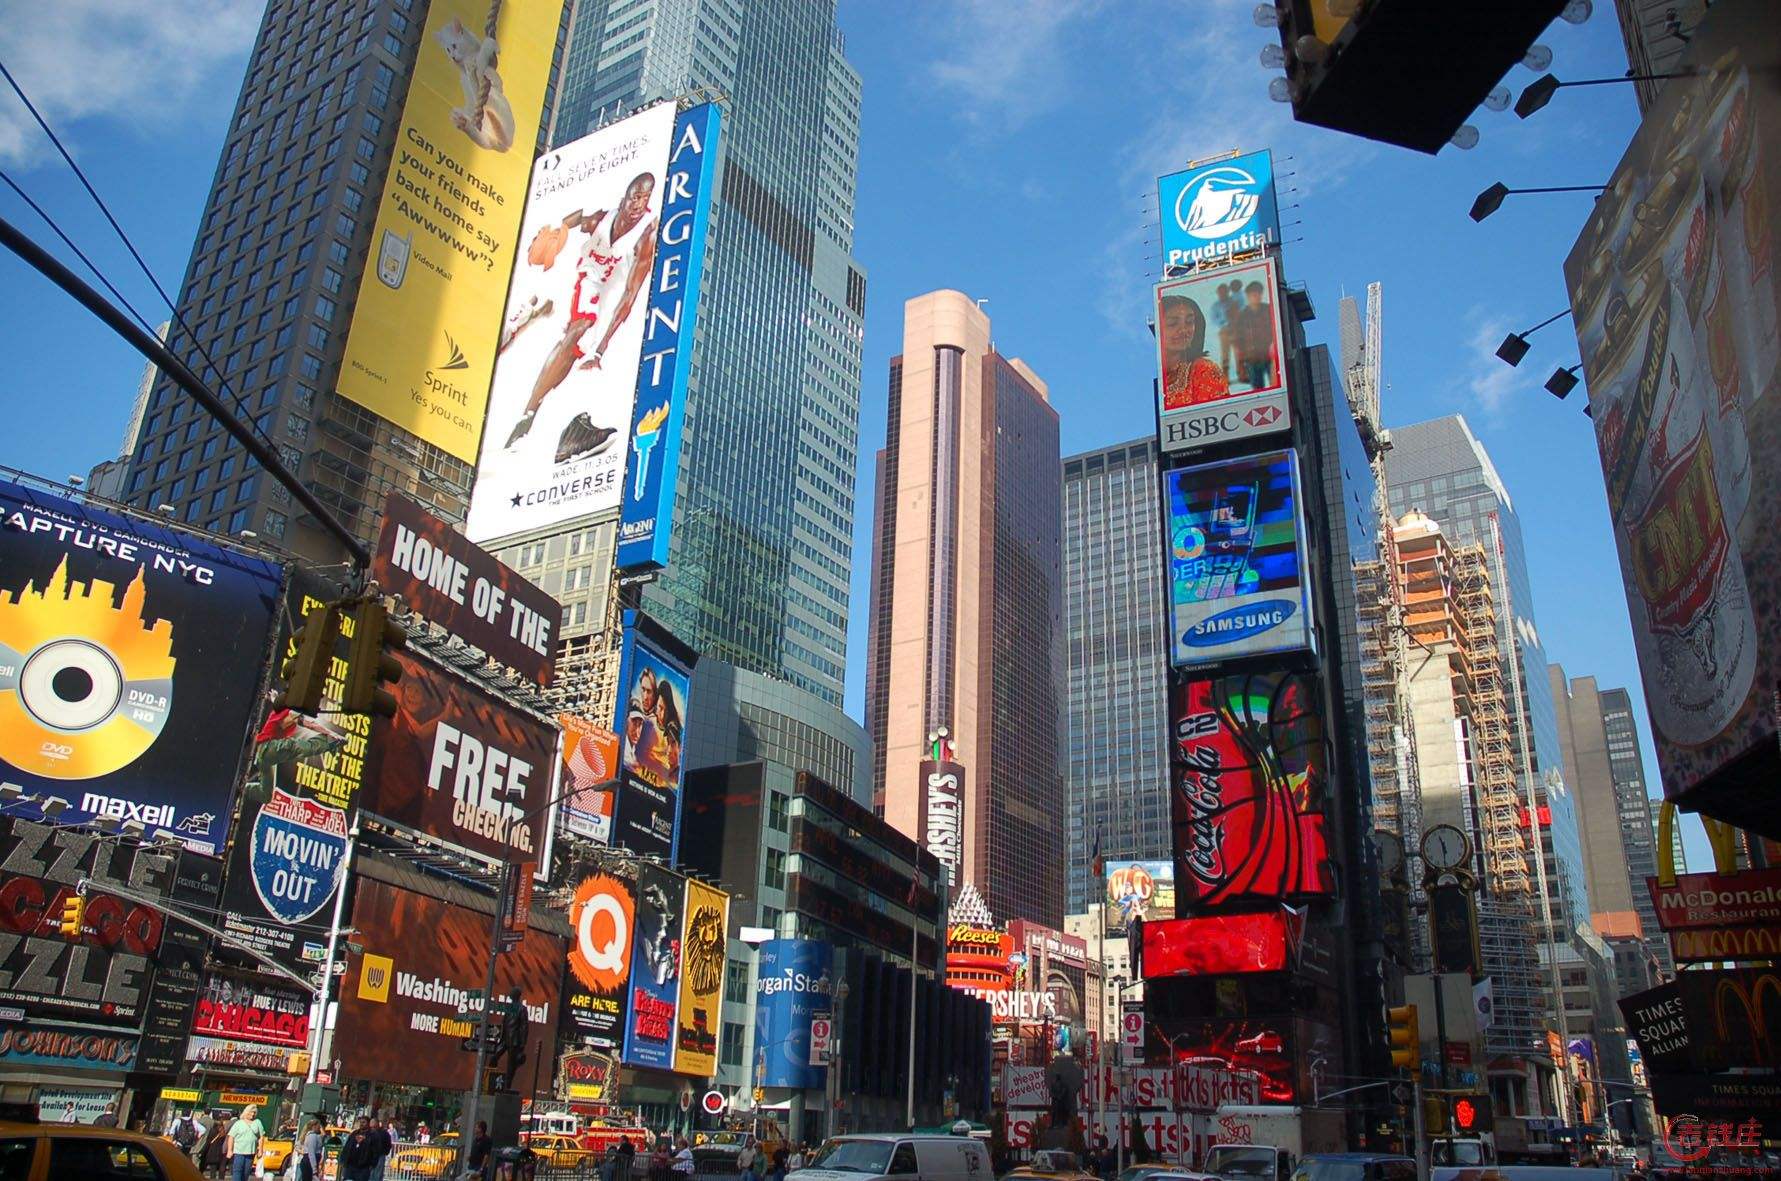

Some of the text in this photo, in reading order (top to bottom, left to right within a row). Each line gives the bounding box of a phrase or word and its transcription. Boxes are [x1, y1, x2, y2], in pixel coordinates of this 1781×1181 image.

[399, 150, 485, 217] your friends
[406, 127, 504, 206] Can you make
[396, 170, 500, 254] back home say
[643, 123, 703, 387] ARGENT
[1168, 227, 1272, 266] Prudential
[413, 250, 452, 282] Video Mail
[410, 388, 428, 409] Yes
[430, 399, 451, 422] you
[424, 370, 468, 406] Sprint
[1167, 412, 1240, 442] HSBC
[526, 469, 616, 506] CONVERSE
[23, 502, 76, 524] MAXELL
[82, 519, 108, 533] DVD
[0, 507, 214, 585] APTURE NYC
[390, 524, 552, 657] HOME OF THE
[1194, 610, 1283, 637] SAMSUNG
[128, 689, 167, 708] DVD-R
[1176, 711, 1219, 740] C2
[42, 742, 73, 755] DVD
[324, 751, 364, 780] OF THE
[296, 762, 361, 800] THEATRE!”
[428, 720, 531, 824] FREE
[80, 792, 176, 828] maxell
[278, 801, 312, 826] THARP
[322, 817, 345, 836] JOEL
[452, 800, 534, 854] CHECKING.
[1179, 744, 1228, 887] Coca-Cola
[263, 826, 340, 870] MOVIN’
[272, 868, 318, 904] OUT
[578, 893, 628, 976] Q
[950, 925, 1001, 944] Reese's
[196, 998, 308, 1042] CHICAGO
[252, 994, 305, 1016] HUEY LEWIS
[570, 994, 620, 1013] ARE HERE.
[410, 1012, 472, 1038] MORE HUMAN
[75, 1102, 86, 1110] for
[222, 1094, 266, 1104] NEWSSTAND
[1712, 1084, 1748, 1095] TIMES
